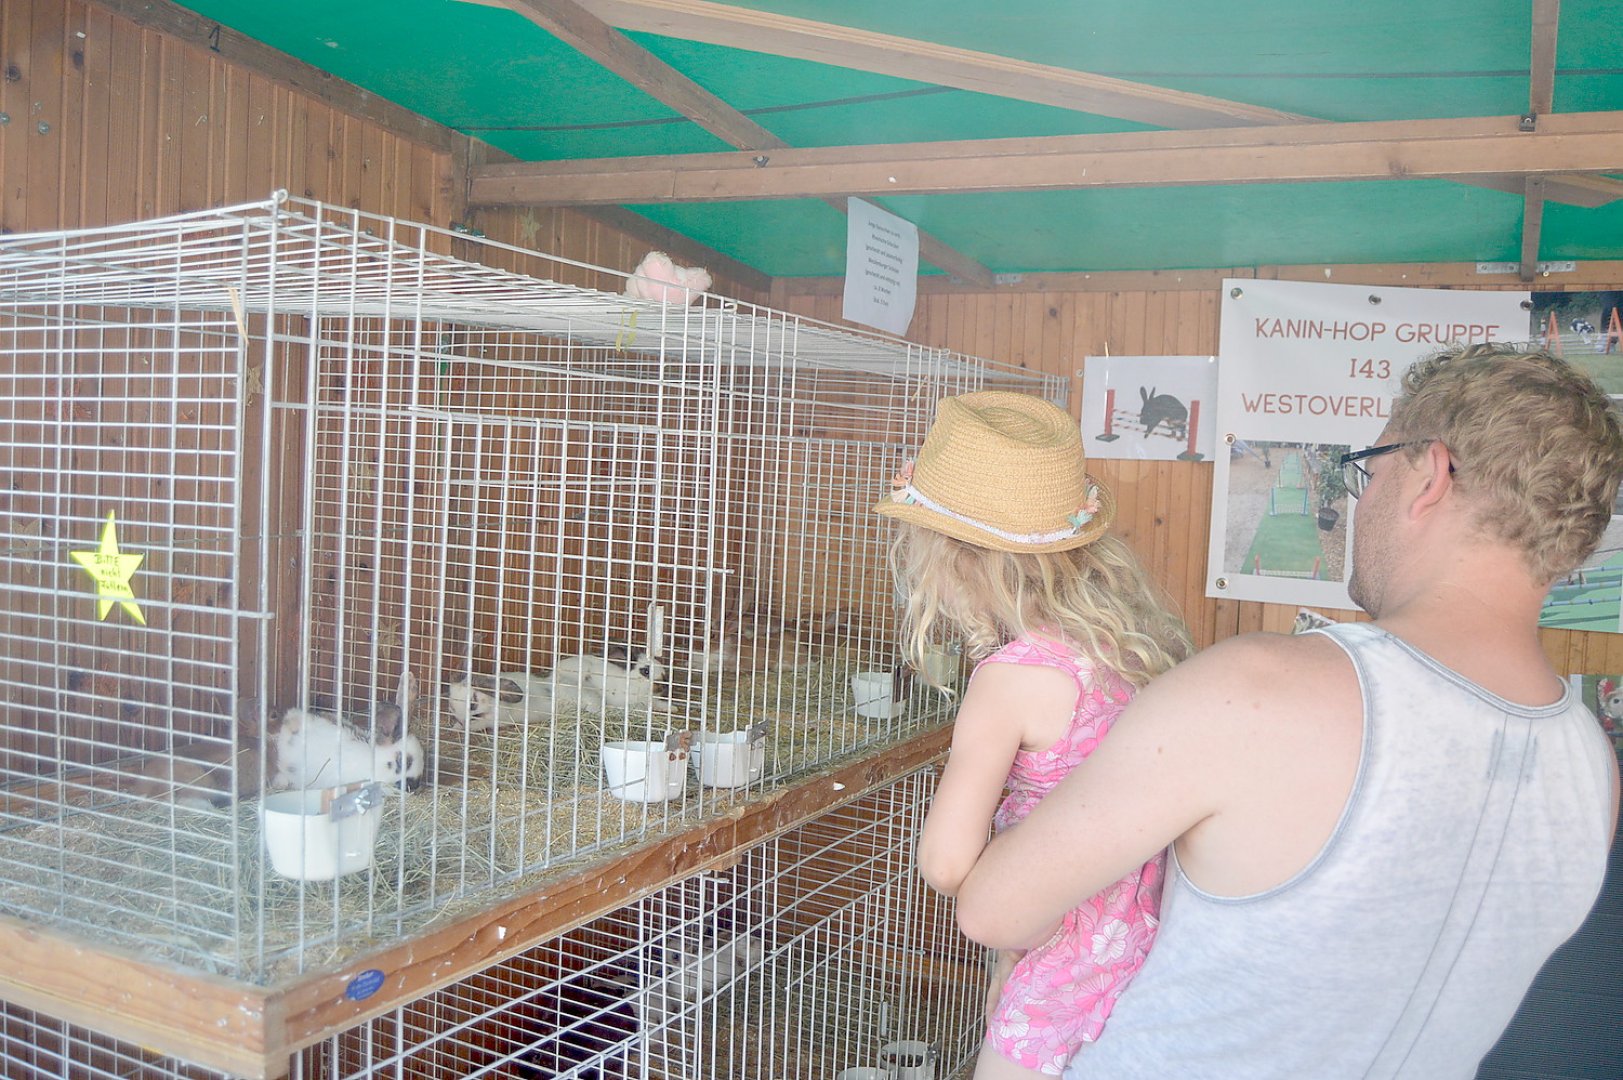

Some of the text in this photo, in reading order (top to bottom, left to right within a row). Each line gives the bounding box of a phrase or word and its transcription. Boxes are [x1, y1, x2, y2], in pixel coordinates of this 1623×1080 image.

[1255, 318, 1500, 344] KANIN-HOP GRUPPE
[1241, 393, 1389, 418] WESTOVERL
